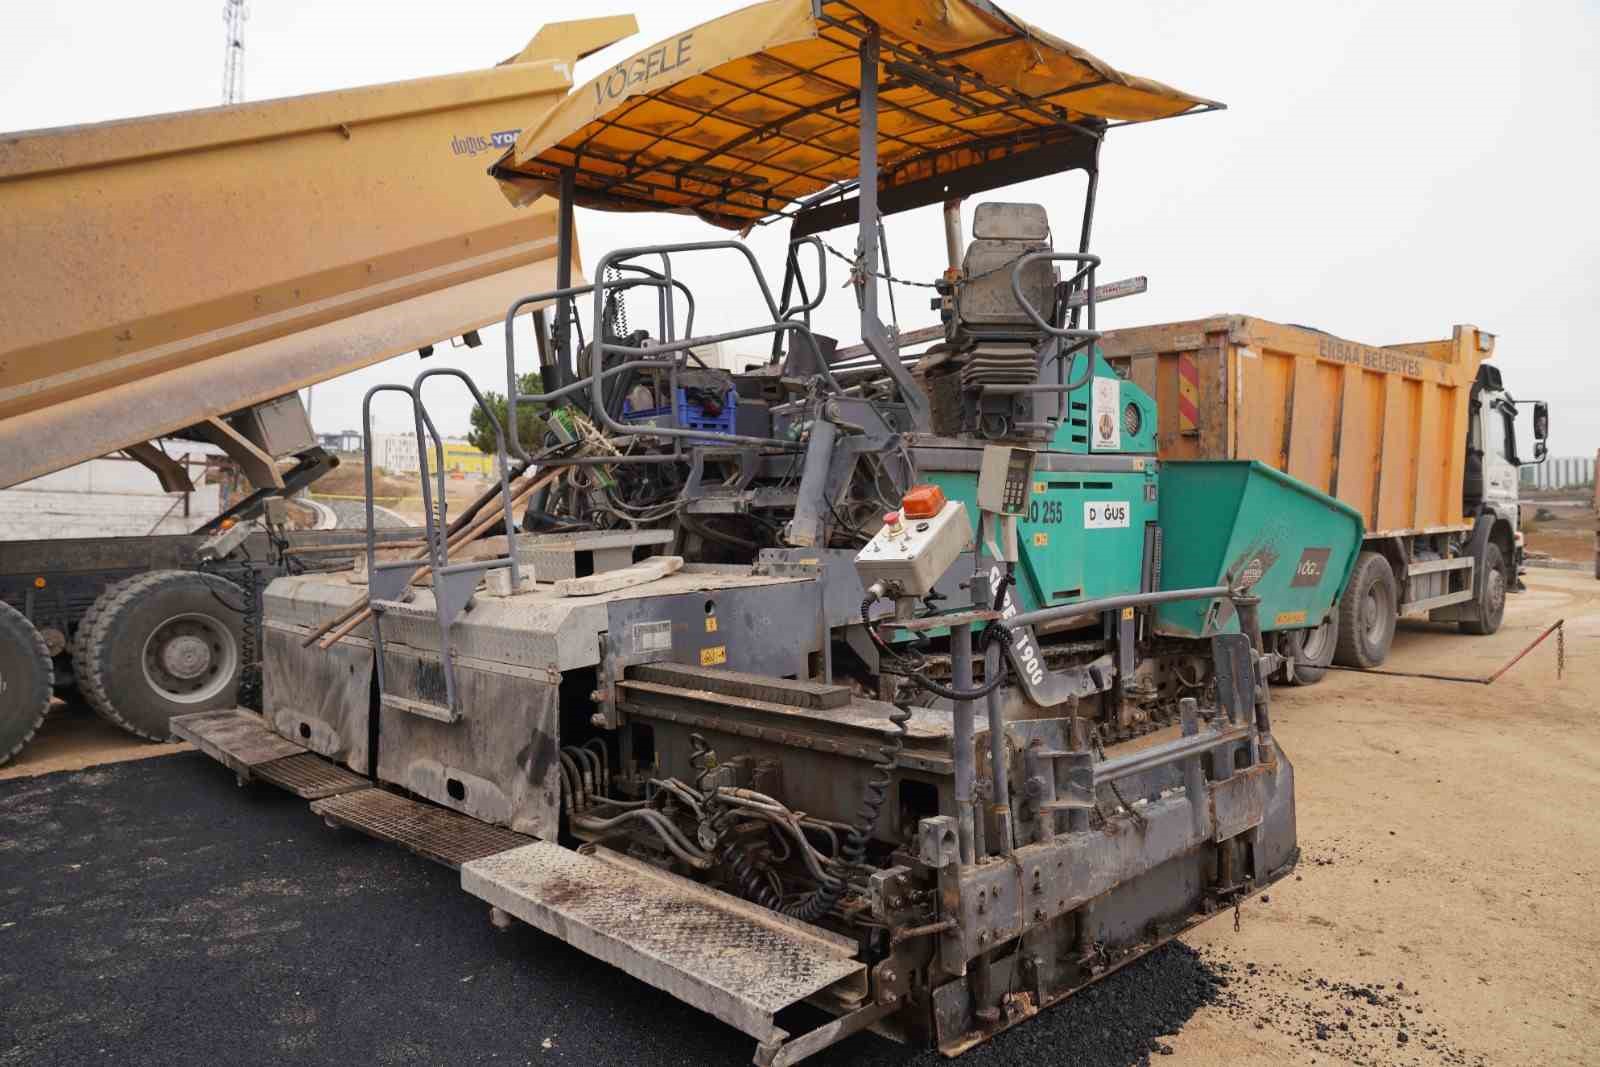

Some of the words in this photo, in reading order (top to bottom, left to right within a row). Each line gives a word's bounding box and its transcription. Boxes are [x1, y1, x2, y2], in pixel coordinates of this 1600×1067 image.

[594, 33, 693, 105] VÖGELE
[1043, 501, 1062, 523] 255
[1016, 634, 1043, 685] 1900
